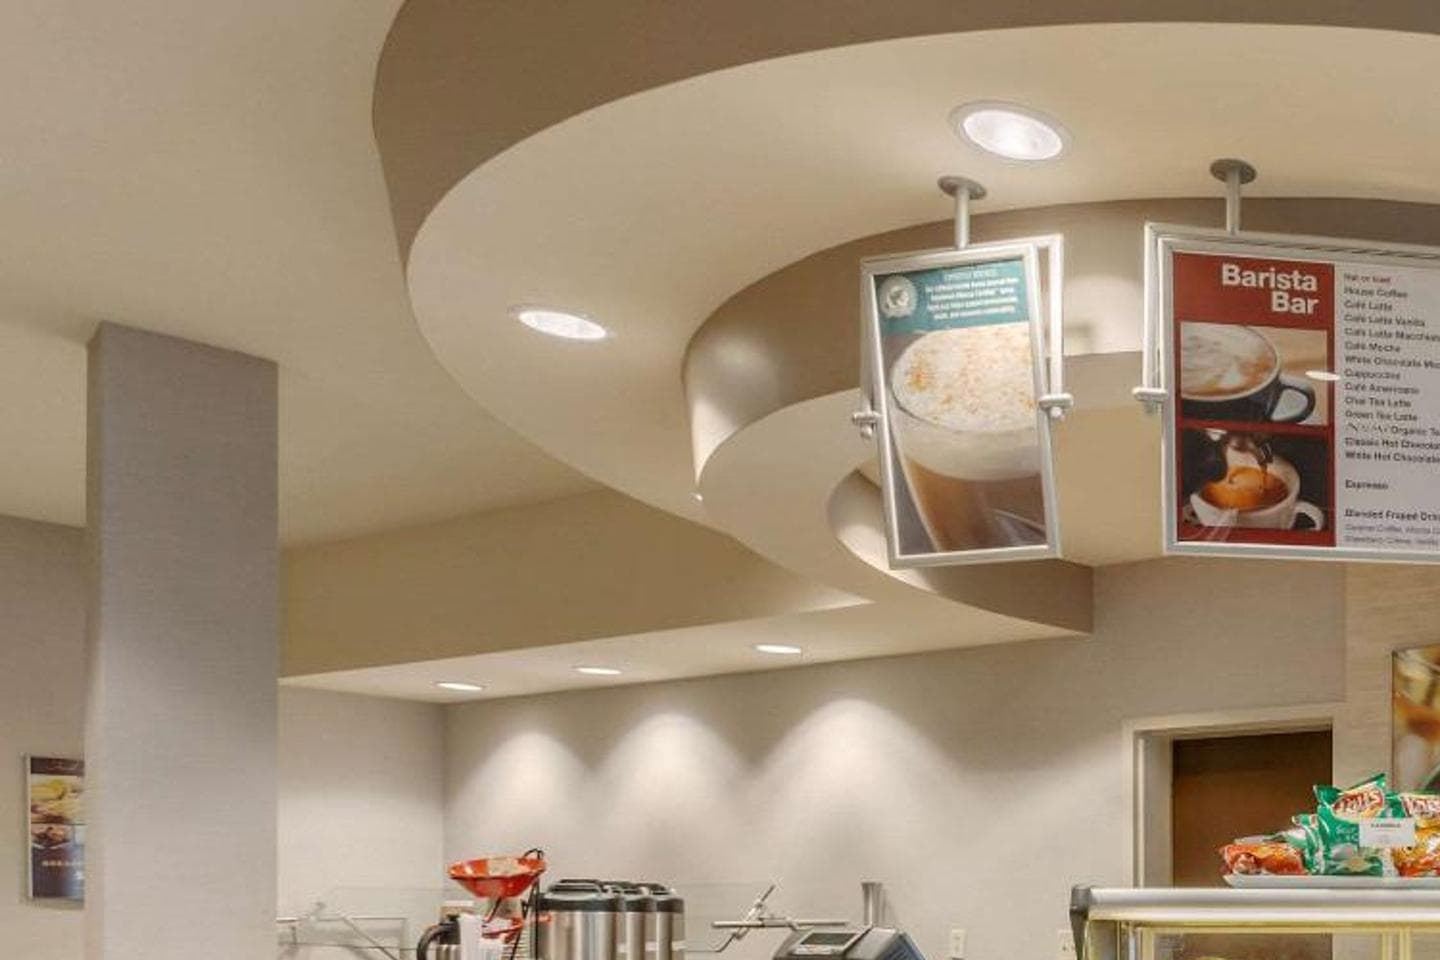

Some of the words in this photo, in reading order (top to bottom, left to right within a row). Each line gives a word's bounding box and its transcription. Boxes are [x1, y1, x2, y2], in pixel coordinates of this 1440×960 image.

[1222, 263, 1317, 292] Barista
[1272, 290, 1319, 315] Bar
[1345, 479, 1389, 490] Espresso
